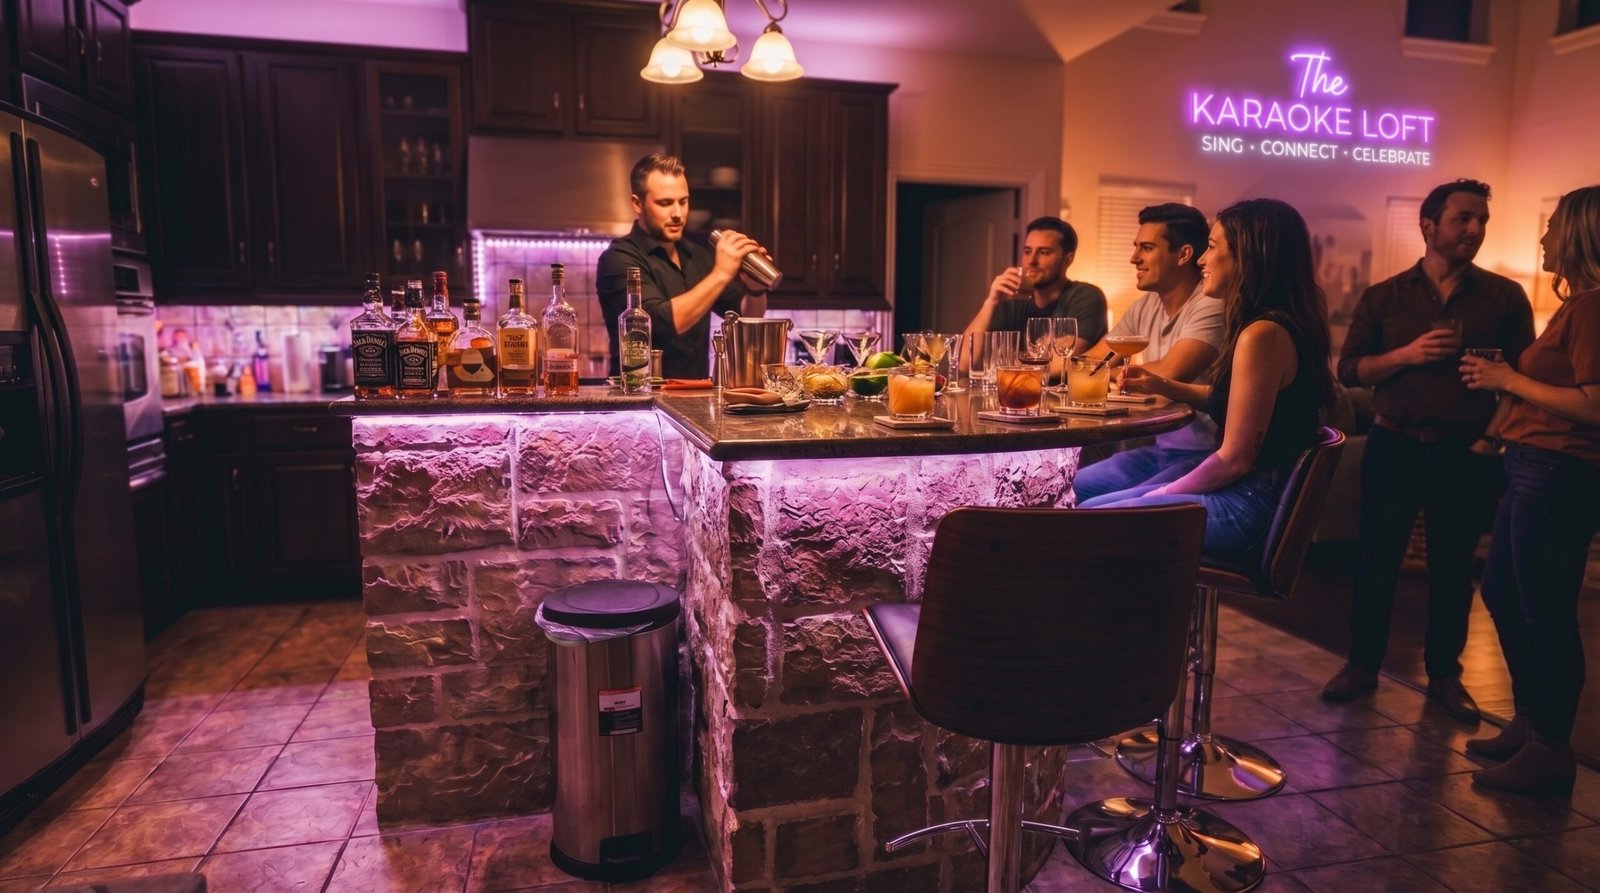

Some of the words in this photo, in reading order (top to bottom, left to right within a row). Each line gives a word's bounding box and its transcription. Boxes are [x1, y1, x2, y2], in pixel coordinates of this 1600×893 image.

[1290, 51, 1348, 98] The
[1193, 92, 1352, 136] KARAOKE
[1363, 109, 1434, 143] LOFT
[1202, 135, 1243, 153] SING
[1261, 139, 1338, 159] CONNECT
[1352, 147, 1431, 166] CELEBRATE
